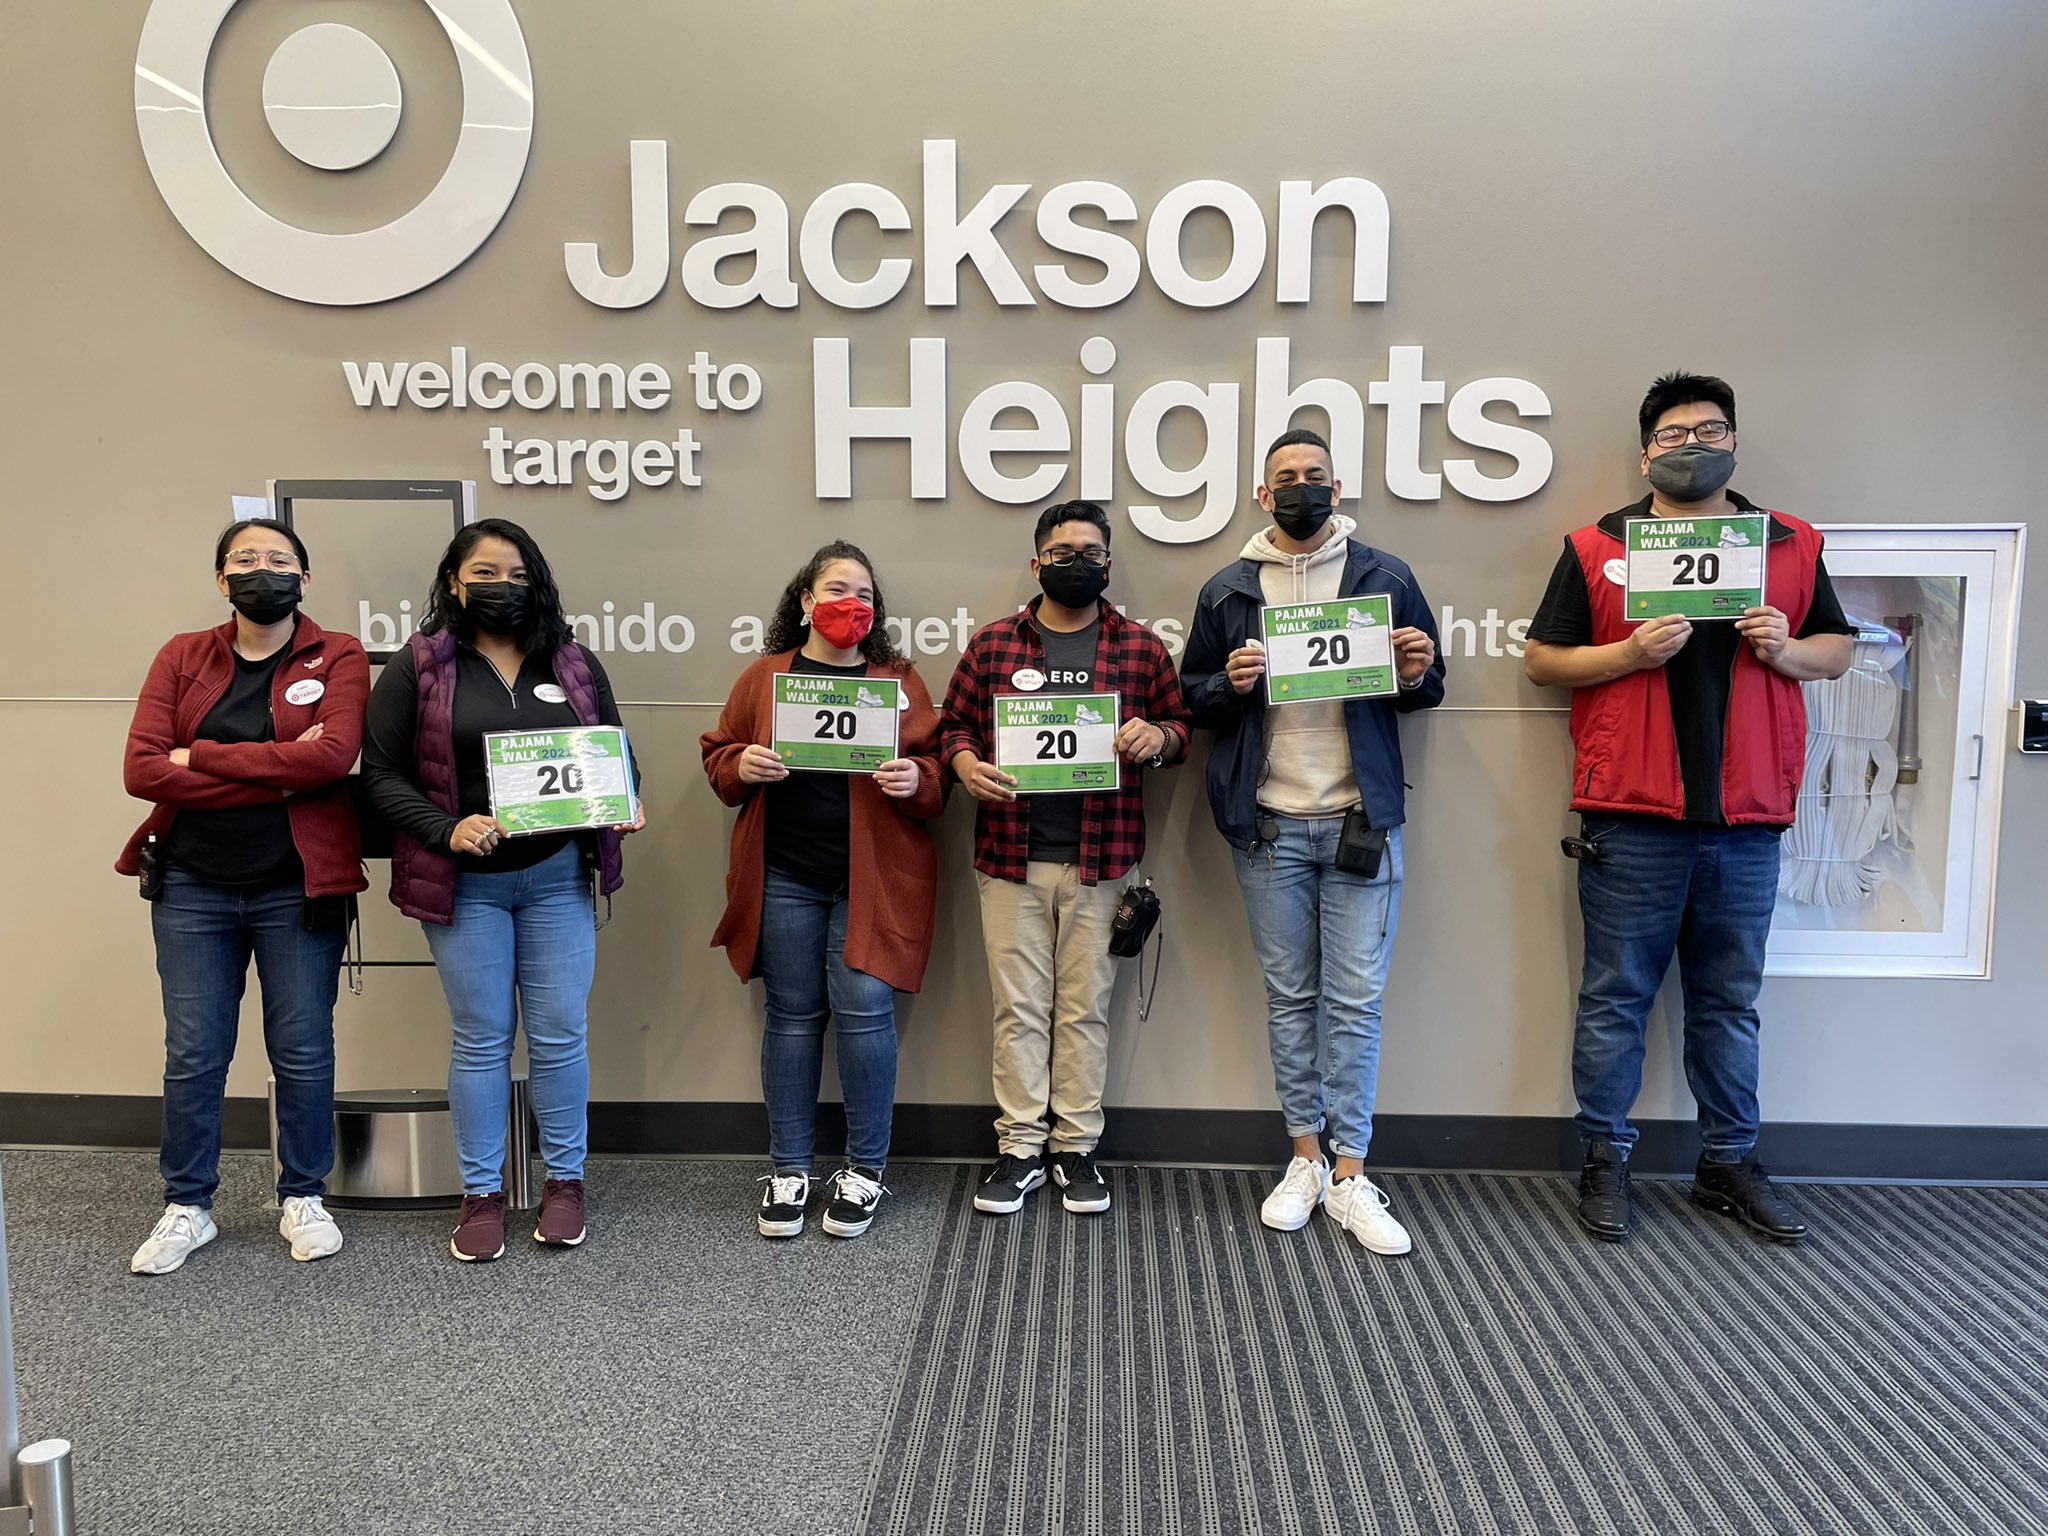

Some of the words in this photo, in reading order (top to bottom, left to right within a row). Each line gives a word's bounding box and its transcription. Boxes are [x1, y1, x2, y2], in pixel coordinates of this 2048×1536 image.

[563, 138, 1391, 309] Jackson
[341, 346, 672, 409] welcome
[688, 351, 762, 410] to
[813, 336, 1554, 544] Heights
[482, 427, 702, 501] target
[1641, 522, 1695, 535] PAJAMA
[1640, 537, 1677, 549] WALK
[1680, 536, 1712, 547] 2021
[1672, 553, 1720, 585] 20
[1274, 606, 1324, 621] PAJAMA
[1275, 621, 1310, 634] WALK
[1312, 618, 1340, 630] 2021
[1307, 634, 1351, 667] 20
[786, 679, 835, 691] PAJAMA
[786, 692, 819, 703] WALK
[822, 694, 849, 705] 2021
[1007, 701, 1054, 712] PAJAMA
[814, 709, 857, 740] 20
[1007, 714, 1039, 725] WALK
[1041, 713, 1069, 724] 2021
[500, 735, 554, 749] PAJAMA
[1036, 729, 1077, 760] 20
[500, 750, 539, 763] WALK
[542, 748, 573, 759] 2021
[536, 763, 584, 796] 20
